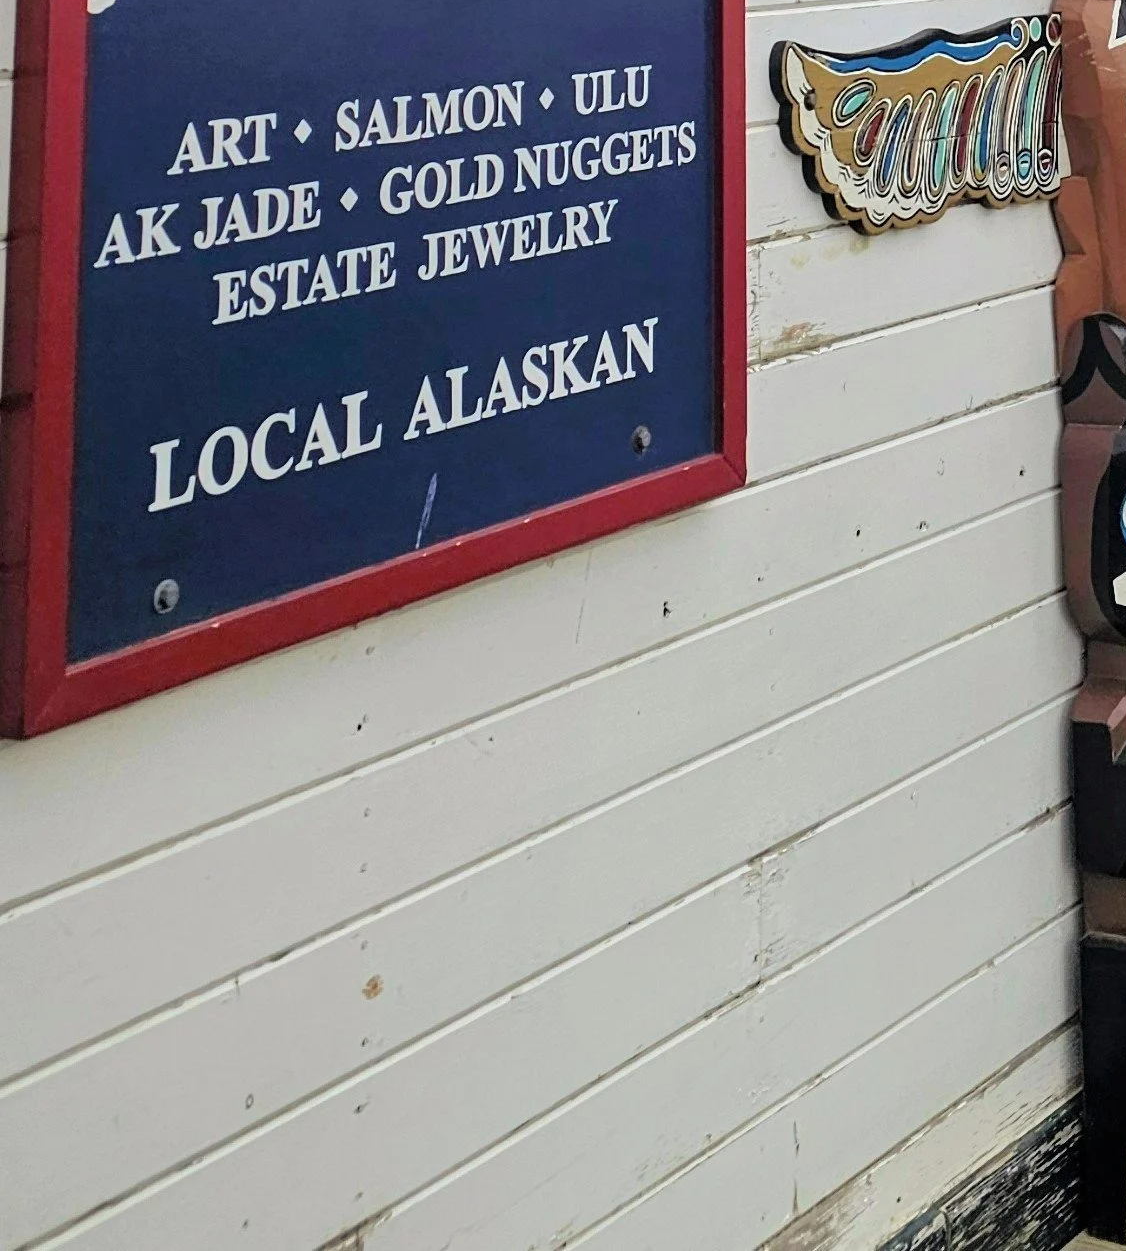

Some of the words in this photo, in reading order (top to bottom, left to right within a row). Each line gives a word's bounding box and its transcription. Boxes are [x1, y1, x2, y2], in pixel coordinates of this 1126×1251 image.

[167, 113, 277, 175] ART
[335, 81, 524, 151] SALMON
[572, 65, 652, 114] ULU
[94, 203, 181, 268] AK
[193, 180, 321, 249] JADE
[379, 153, 504, 215] GOLD
[513, 121, 697, 192] NUGGETS
[212, 241, 396, 325] ESTATE
[417, 200, 618, 280] JEWELRY
[148, 390, 383, 512] LOCAL
[404, 317, 659, 441] ALASKAN
